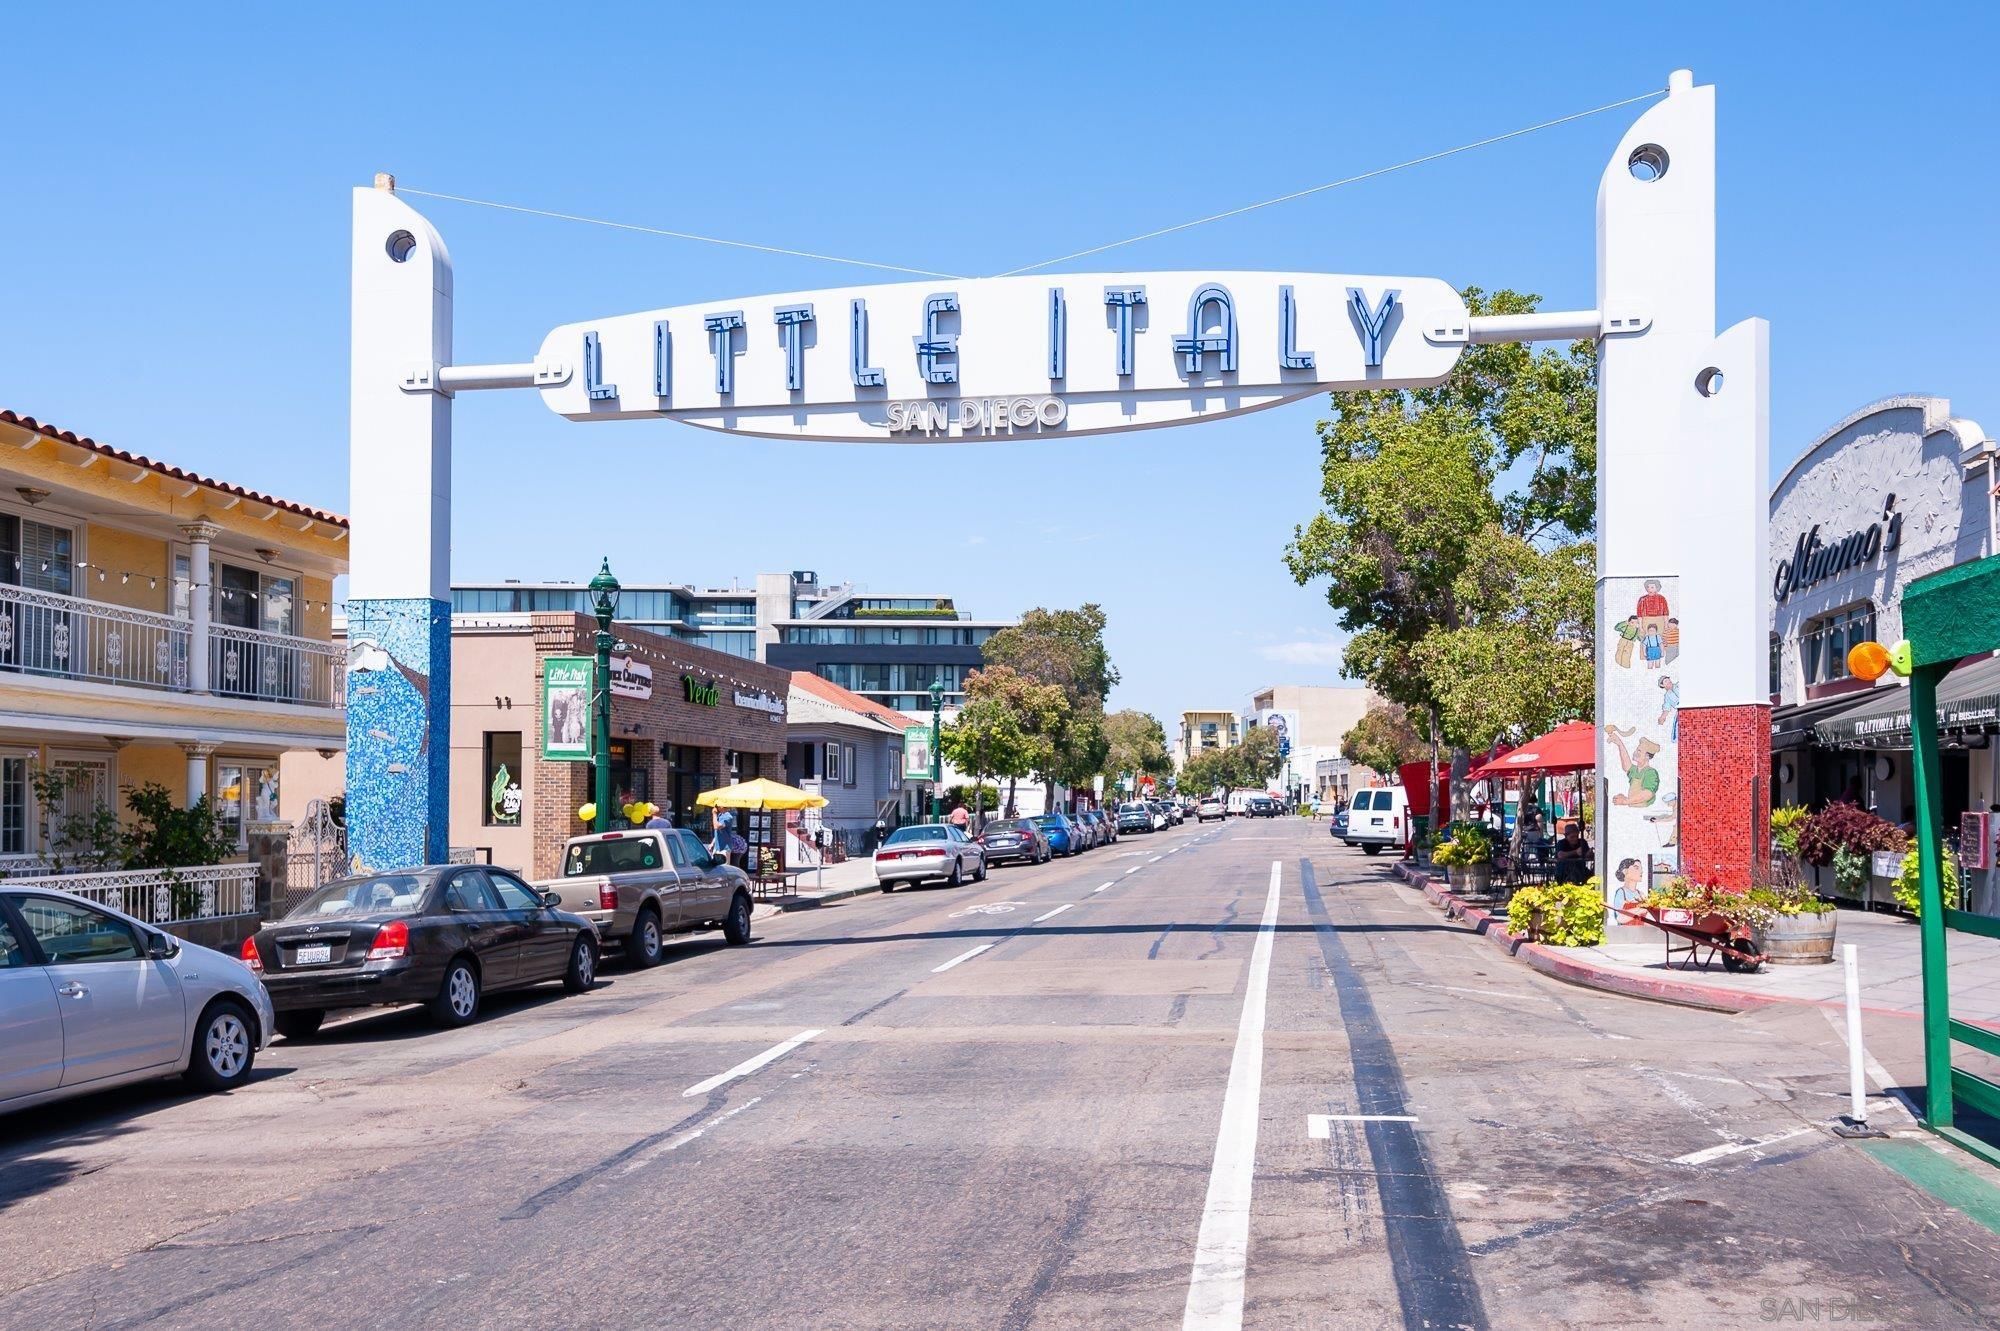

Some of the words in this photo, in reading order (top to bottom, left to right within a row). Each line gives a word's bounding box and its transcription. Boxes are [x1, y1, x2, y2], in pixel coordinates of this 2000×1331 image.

[583, 291, 959, 401] LITTLE
[1048, 281, 1402, 380] ITALY
[886, 400, 948, 432] SAN
[958, 396, 1067, 431] DIEGO
[1773, 492, 1902, 602] Mimmo's
[548, 664, 570, 682] Little
[570, 662, 588, 688] Italy
[683, 674, 721, 708] Verde
[1855, 717, 1894, 735] TRATTORIA
[1949, 712, 1958, 722] BY
